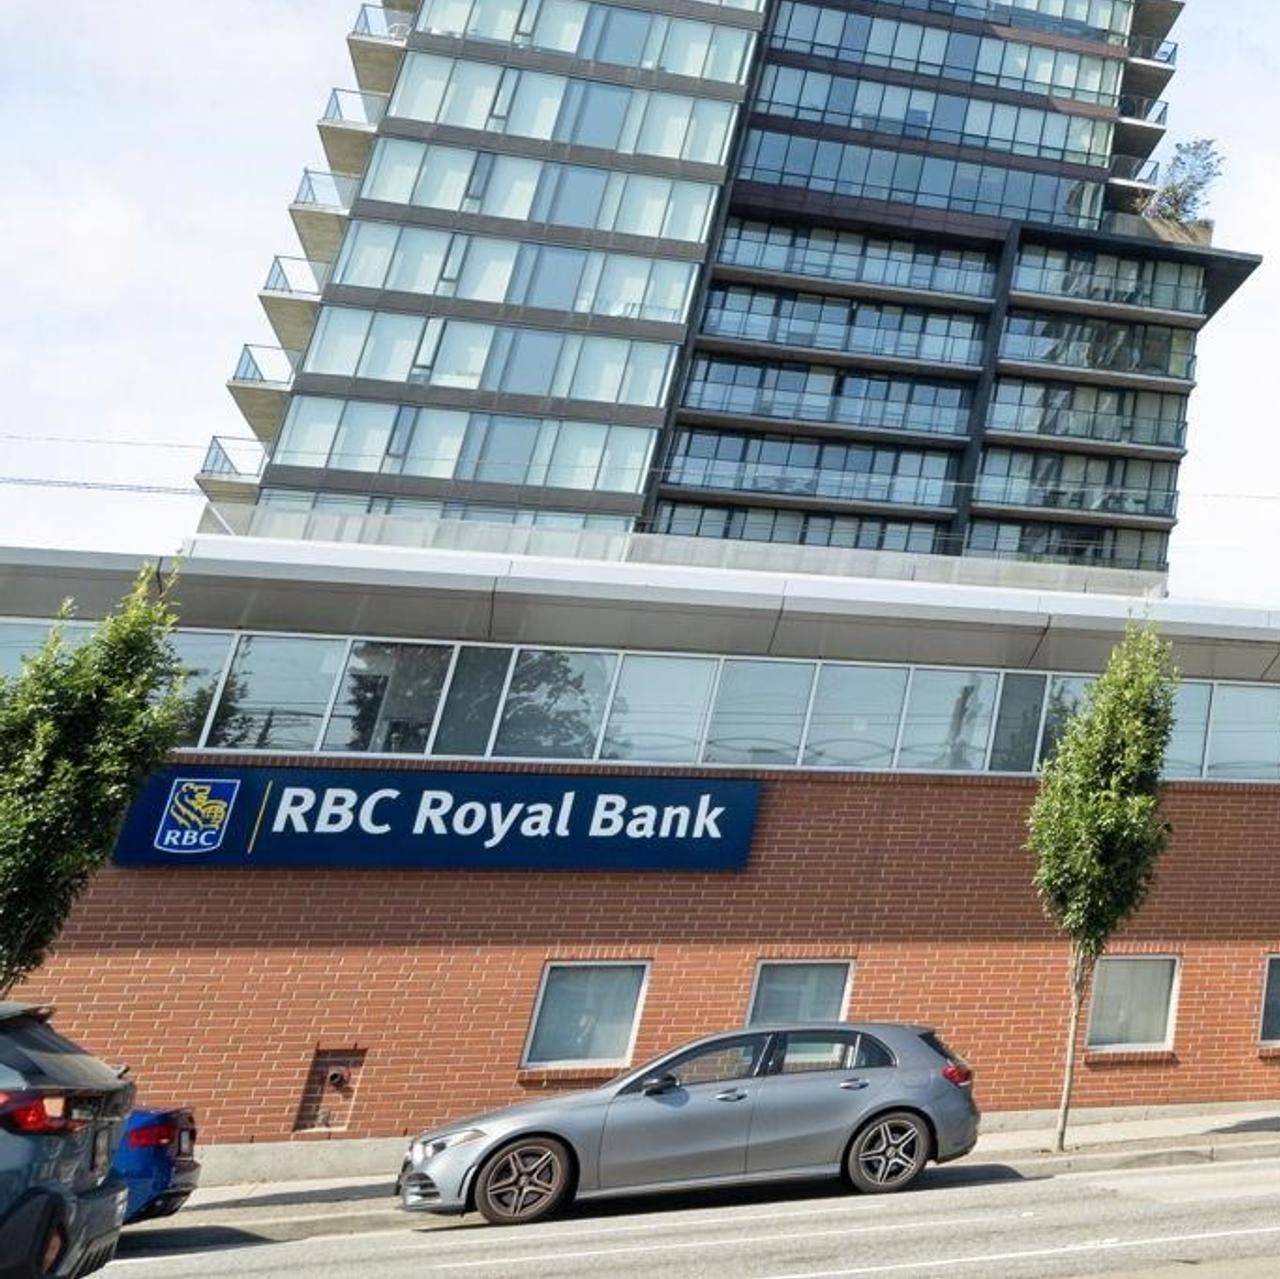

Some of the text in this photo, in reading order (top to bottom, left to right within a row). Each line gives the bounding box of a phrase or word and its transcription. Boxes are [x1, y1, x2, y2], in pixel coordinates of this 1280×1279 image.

[162, 829, 217, 846] RBC
[272, 787, 726, 849] RBC Royal Bank
